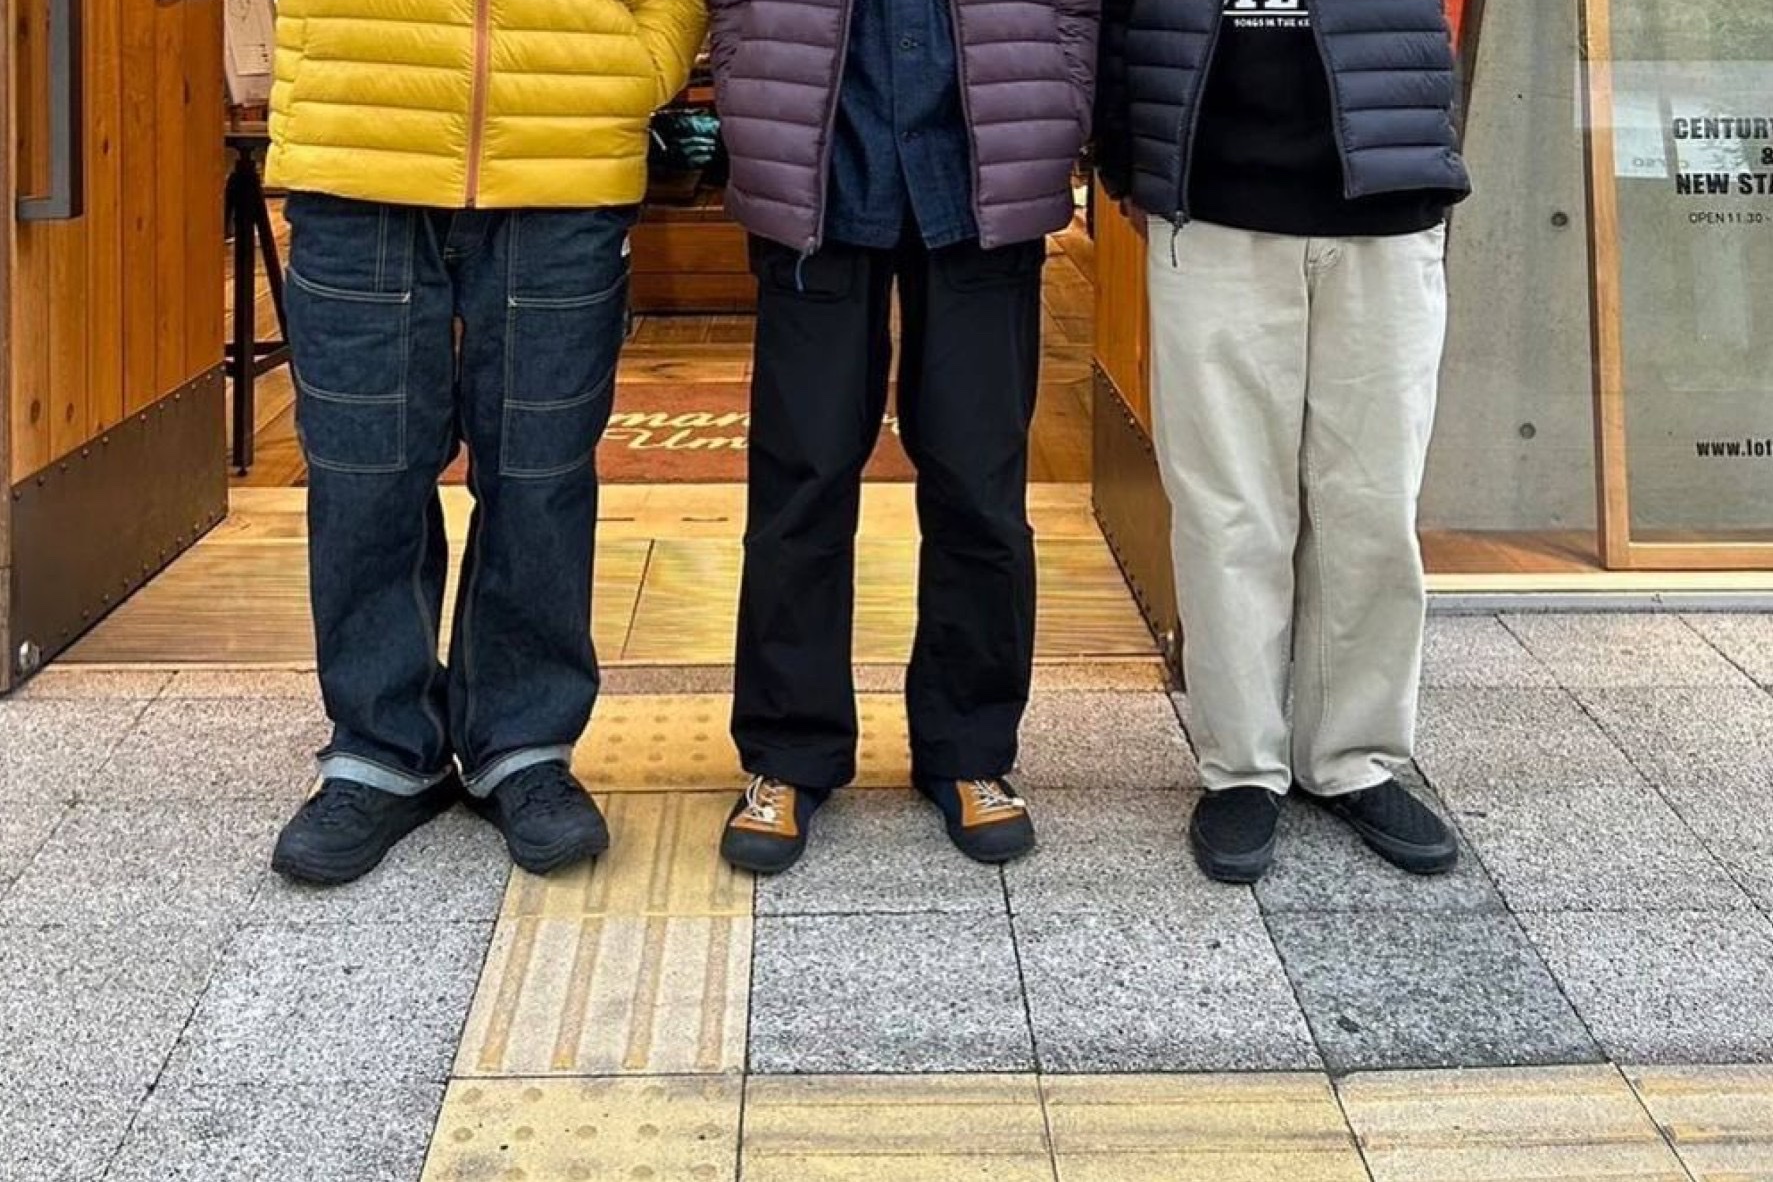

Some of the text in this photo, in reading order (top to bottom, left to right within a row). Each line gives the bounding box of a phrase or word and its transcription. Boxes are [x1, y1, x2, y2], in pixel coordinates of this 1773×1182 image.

[1673, 117, 1773, 139] CENTUR
[1675, 173, 1773, 194] NEW ST
[1689, 212, 1725, 224] OPEN
